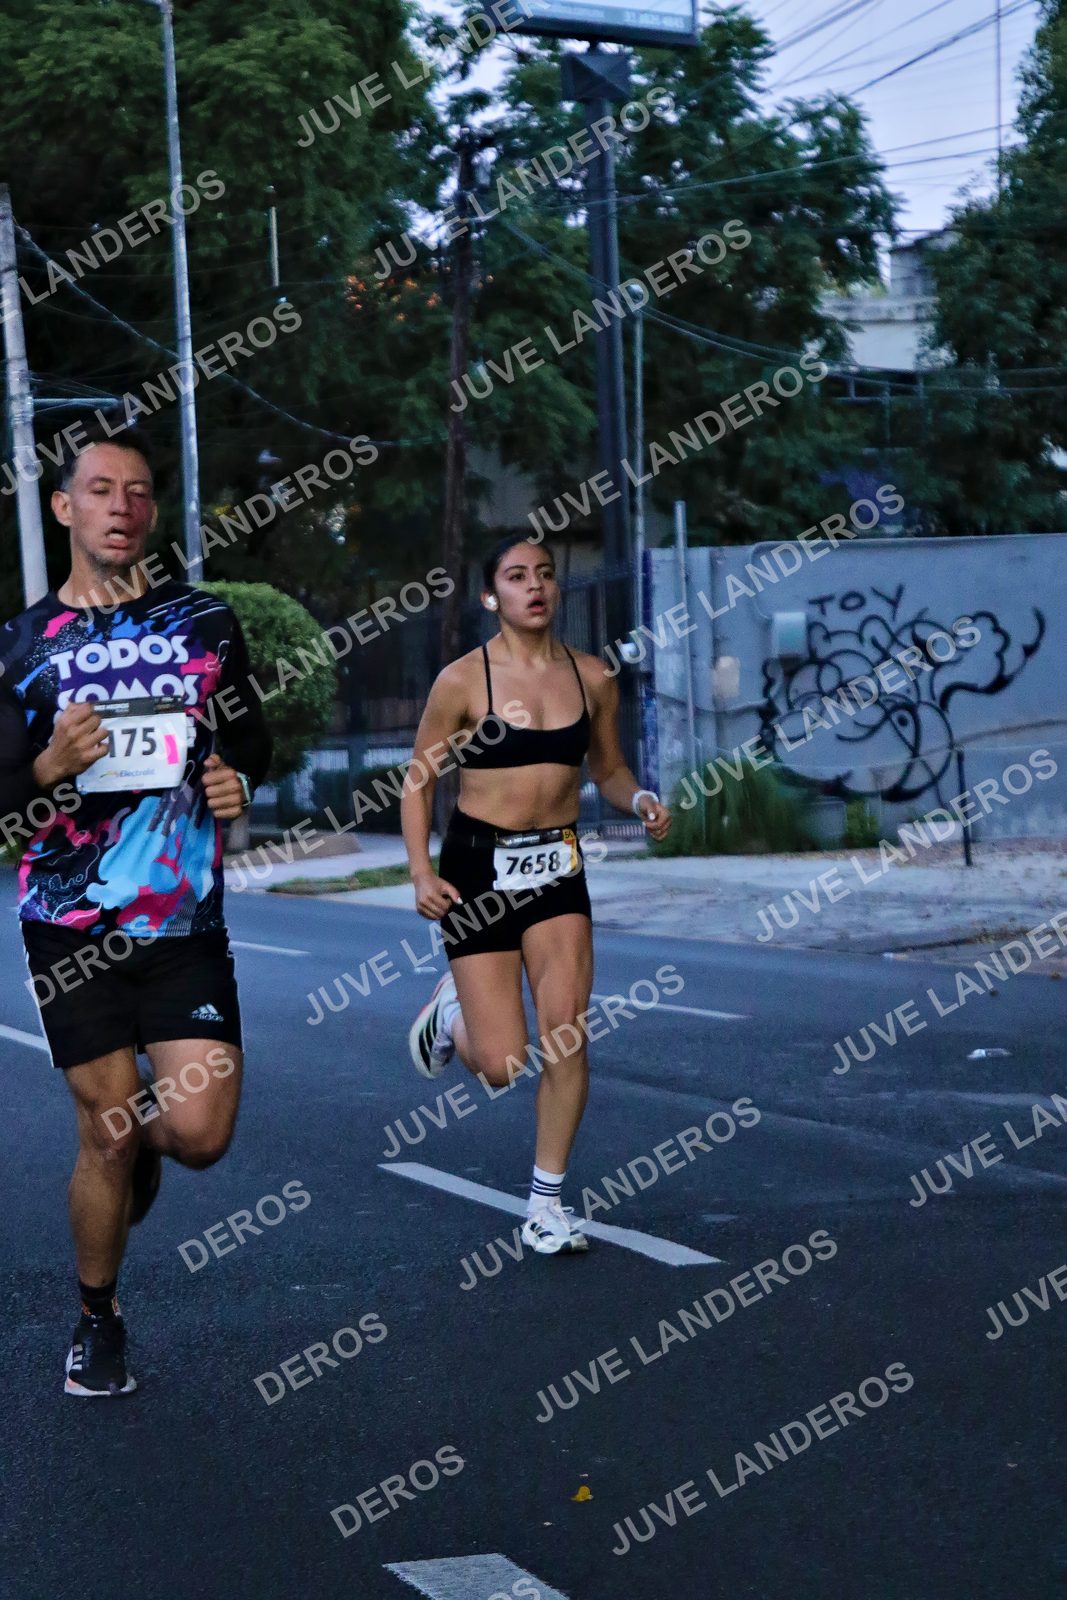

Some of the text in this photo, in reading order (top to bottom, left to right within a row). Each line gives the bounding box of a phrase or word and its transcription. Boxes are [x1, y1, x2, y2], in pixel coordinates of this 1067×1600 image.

[808, 584, 904, 621] TOY
[49, 634, 189, 680] TODOS
[506, 850, 561, 876] 7658
